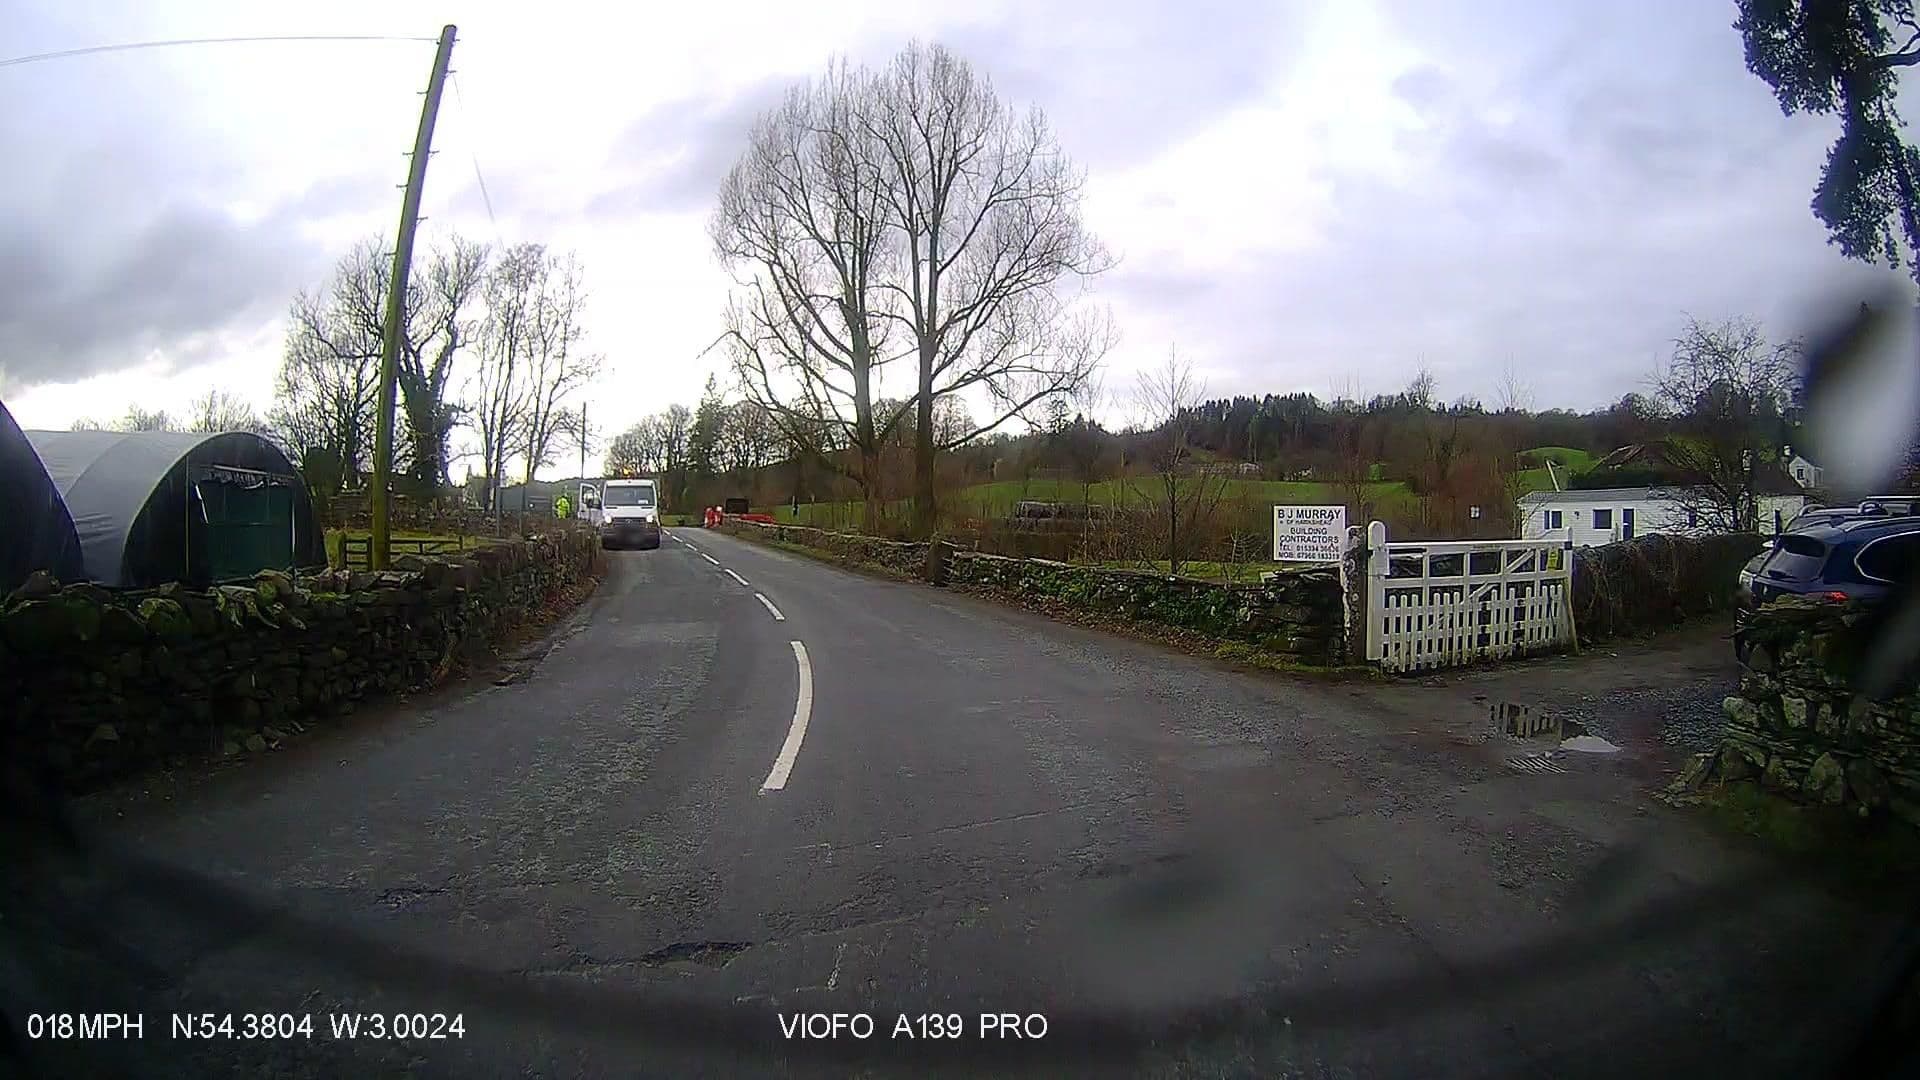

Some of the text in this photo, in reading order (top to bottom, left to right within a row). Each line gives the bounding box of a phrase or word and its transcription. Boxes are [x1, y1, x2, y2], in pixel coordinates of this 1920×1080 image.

[1278, 509, 1341, 519] B J MURRAY
[1290, 527, 1328, 535] BUILDING
[1279, 535, 1339, 544] CONTRACTORS
